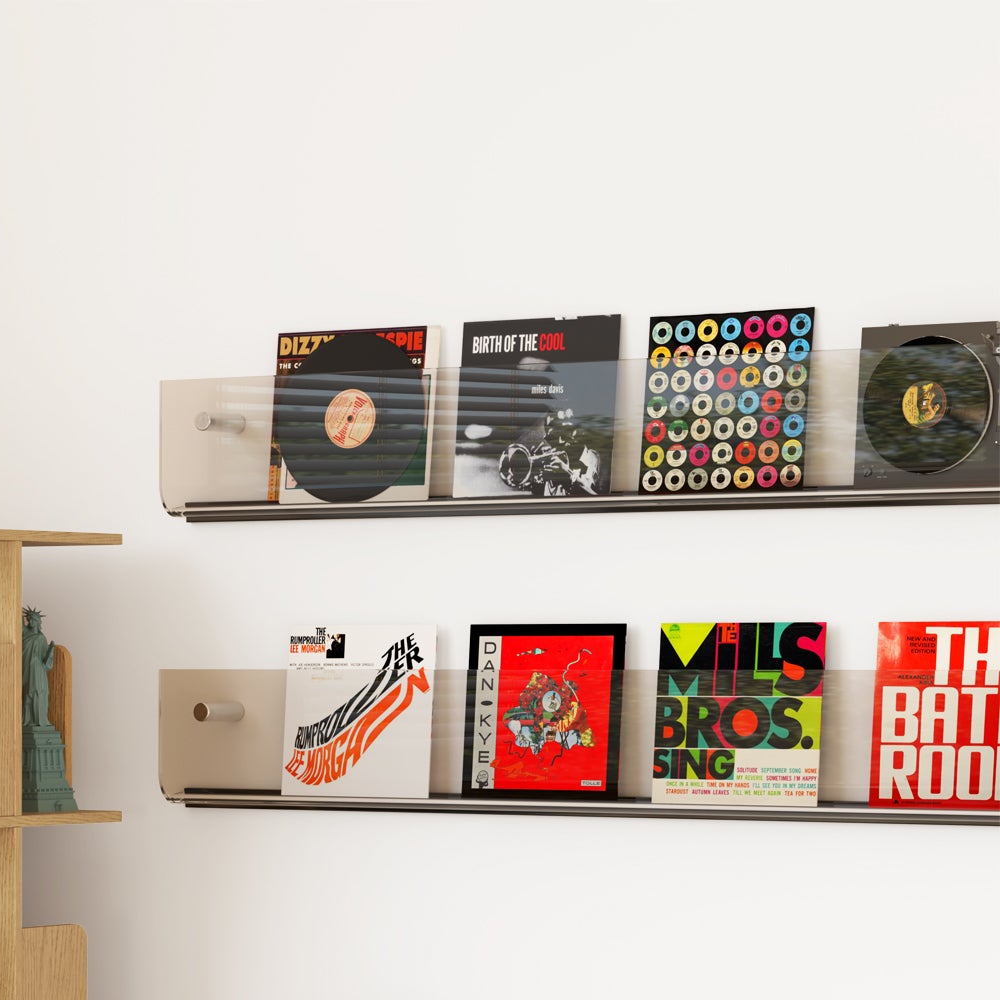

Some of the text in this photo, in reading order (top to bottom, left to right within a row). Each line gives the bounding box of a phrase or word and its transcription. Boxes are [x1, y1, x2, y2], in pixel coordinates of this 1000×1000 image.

[472, 332, 566, 354] BIRTH OF THE COOL
[279, 362, 292, 370] THE
[531, 384, 564, 394] miles davis
[316, 627, 326, 636] THE
[290, 635, 326, 645] RUMPROLLER
[290, 644, 326, 653] LEE MORGAN
[881, 686, 1000, 744] BAT
[653, 696, 814, 750] BROS.
[652, 749, 735, 780] SING
